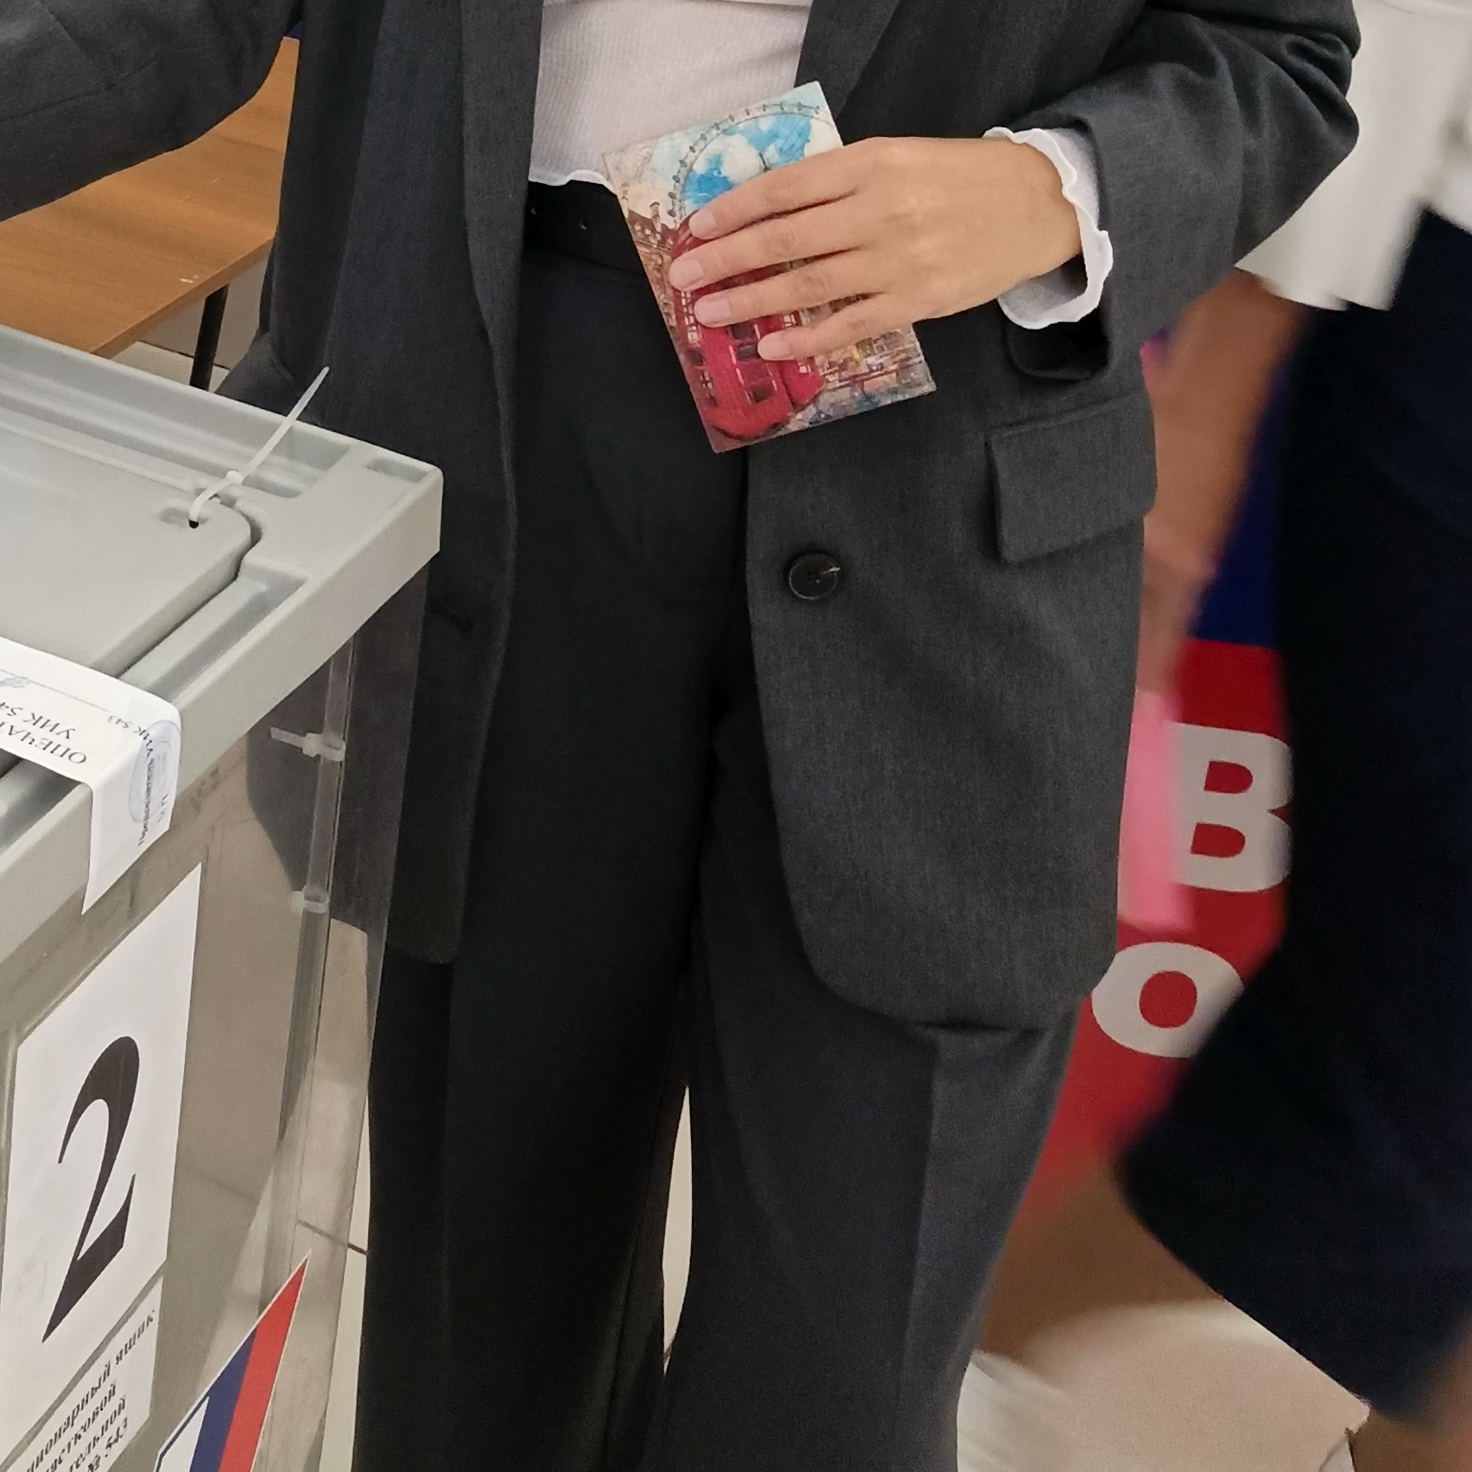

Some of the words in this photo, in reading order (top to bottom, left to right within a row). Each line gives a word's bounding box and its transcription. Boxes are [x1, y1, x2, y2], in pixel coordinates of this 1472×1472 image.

[23, 711, 76, 741] УИК
[41, 1035, 140, 1344] 2
[115, 1309, 156, 1366] ящик
[46, 1379, 117, 1472] астковой
